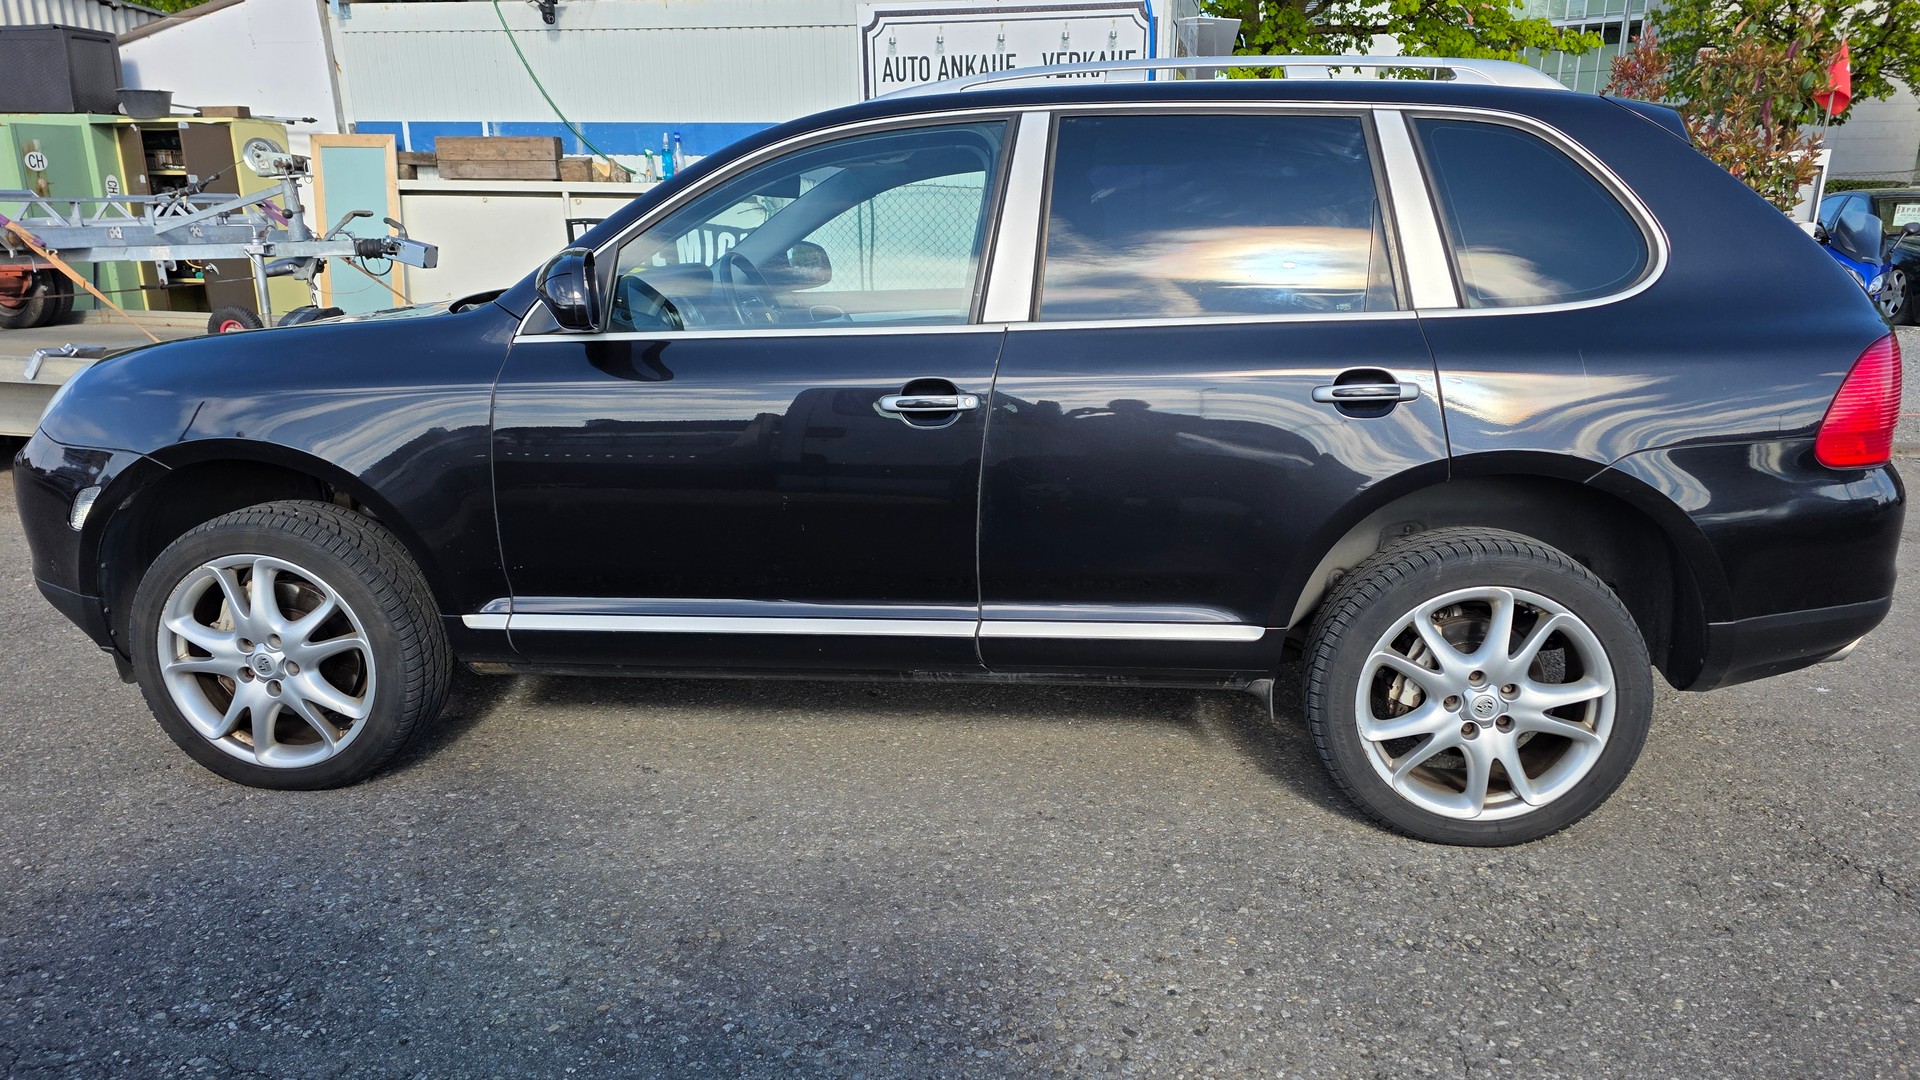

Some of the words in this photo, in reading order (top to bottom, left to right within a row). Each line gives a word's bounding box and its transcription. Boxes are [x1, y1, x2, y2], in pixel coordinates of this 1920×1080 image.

[882, 55, 931, 82] AUTO
[937, 53, 1017, 81] ANKAUF
[28, 154, 45, 169] CH
[107, 180, 118, 194] CH
